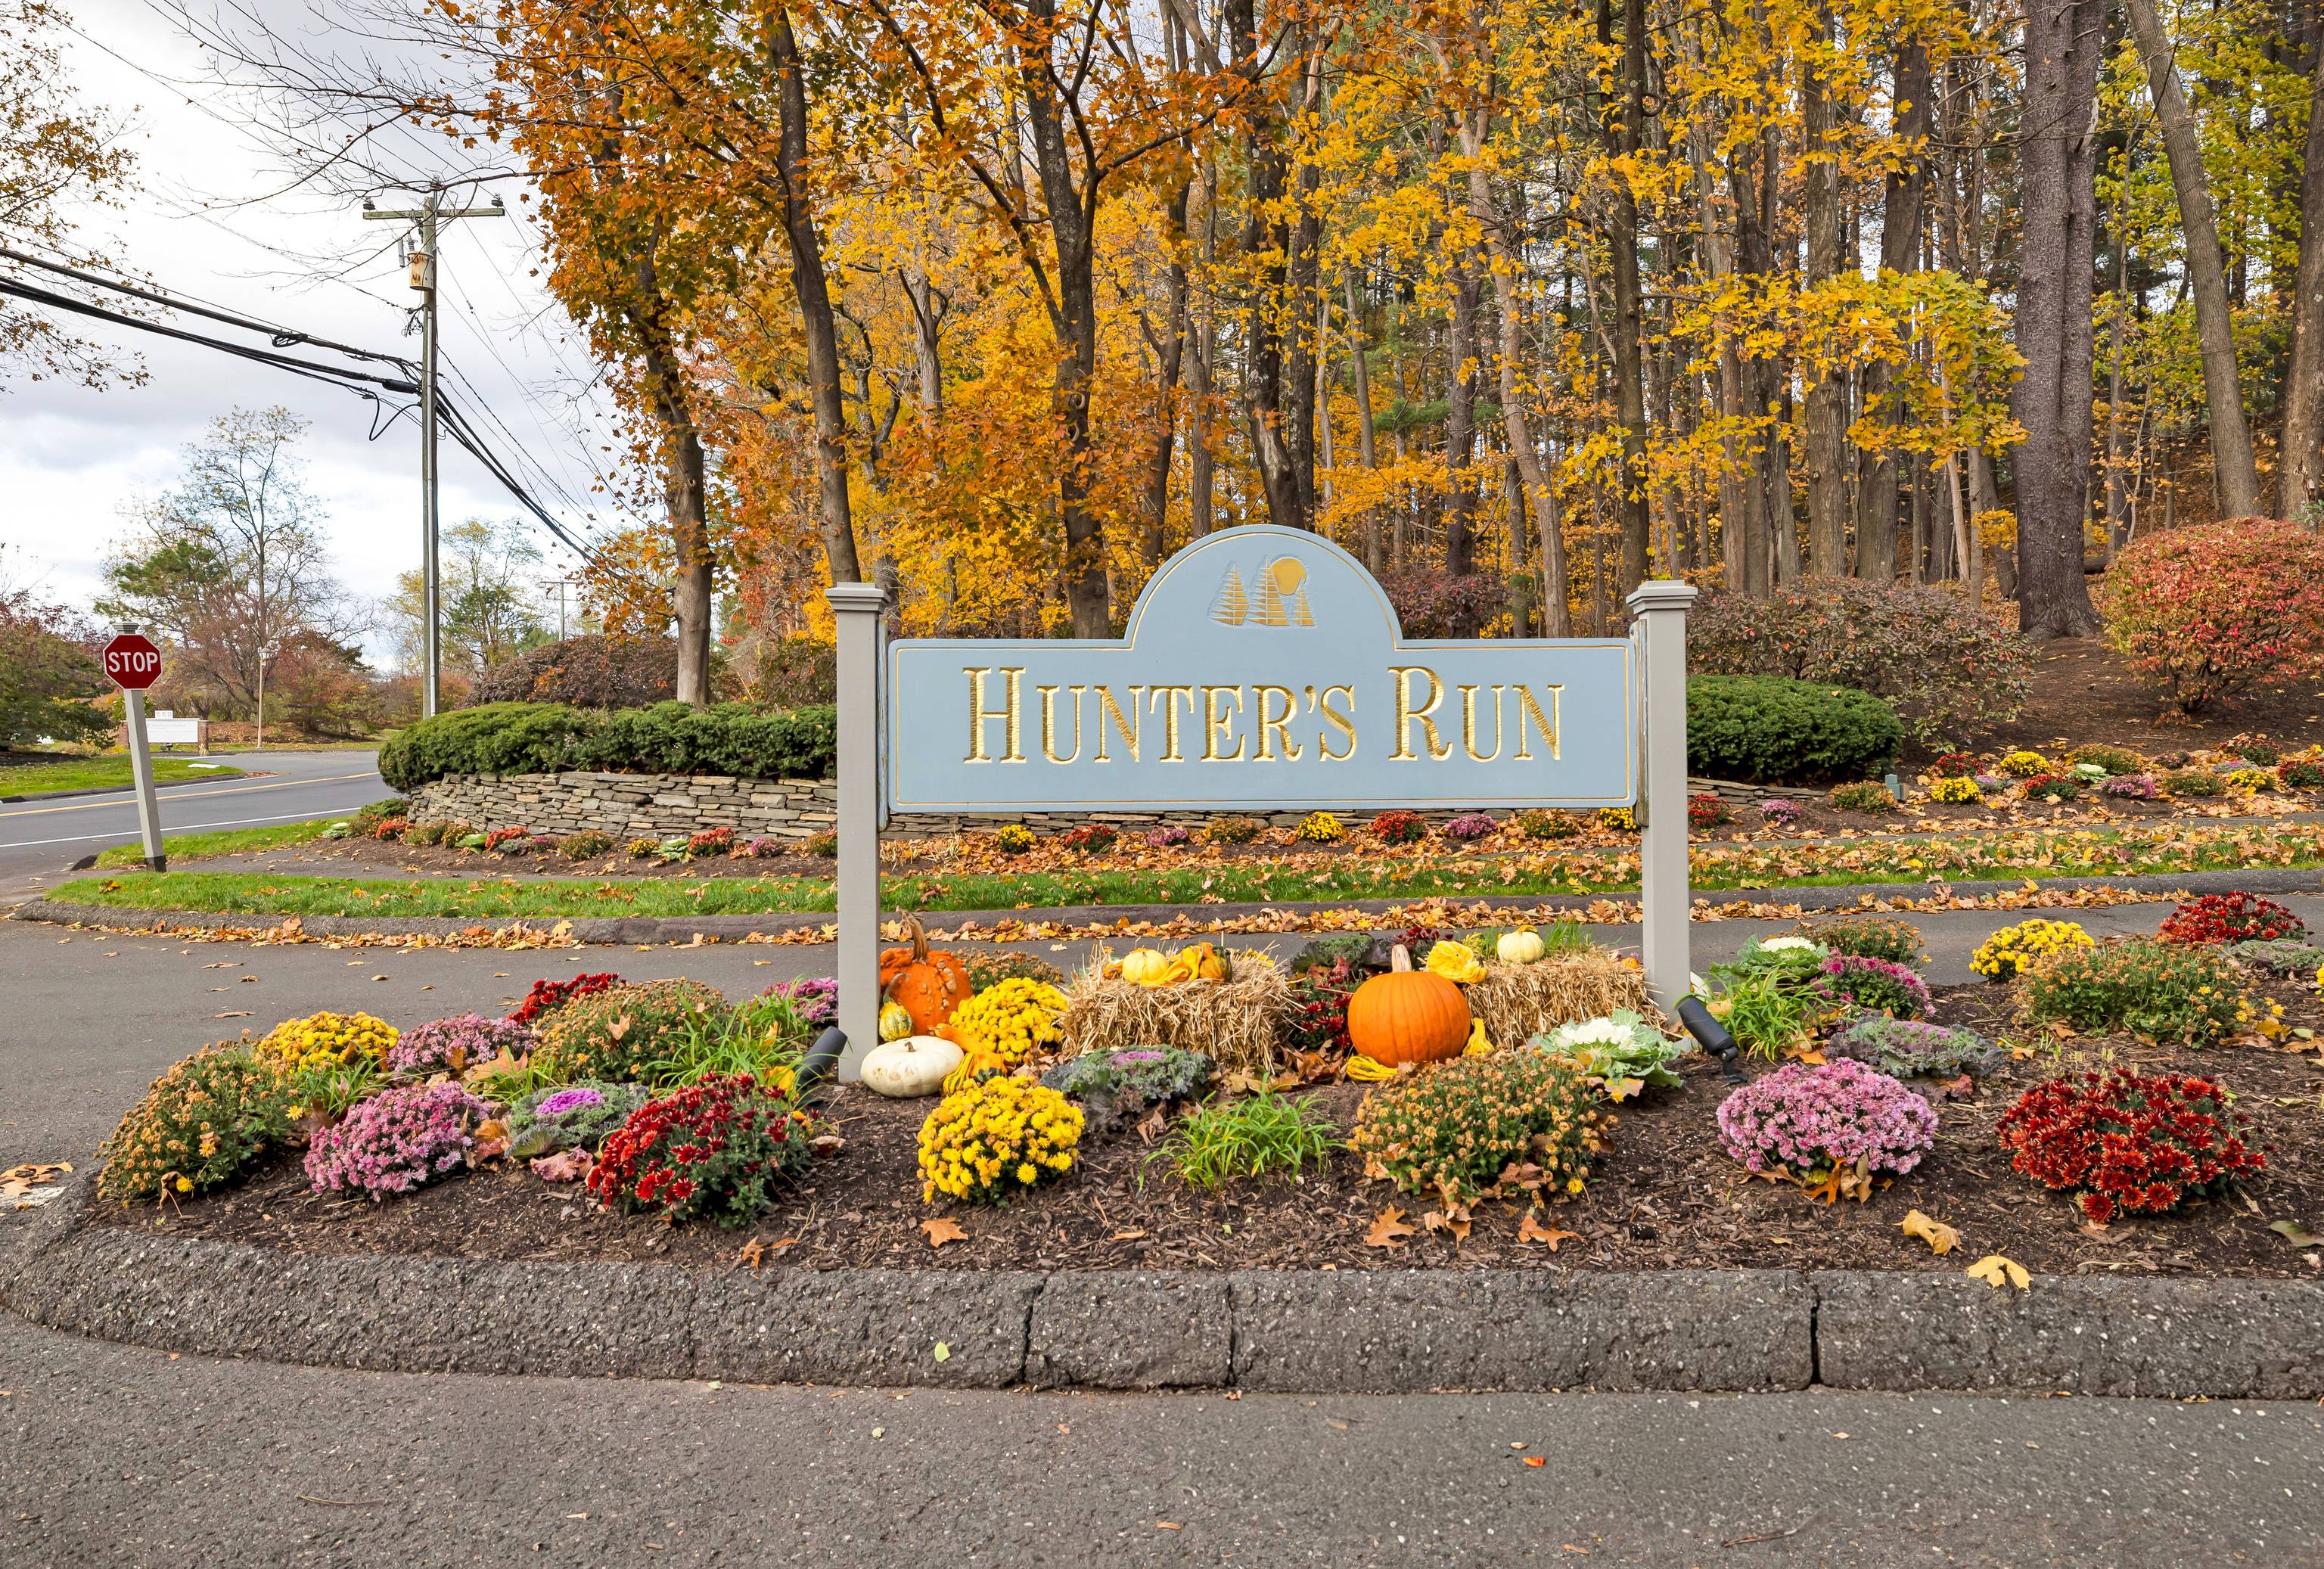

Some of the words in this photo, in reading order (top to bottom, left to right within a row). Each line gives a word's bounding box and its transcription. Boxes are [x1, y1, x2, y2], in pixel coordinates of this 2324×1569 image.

[108, 651, 158, 673] STOP
[962, 666, 1357, 763] HUNTER'S
[1387, 666, 1564, 763] RUN
